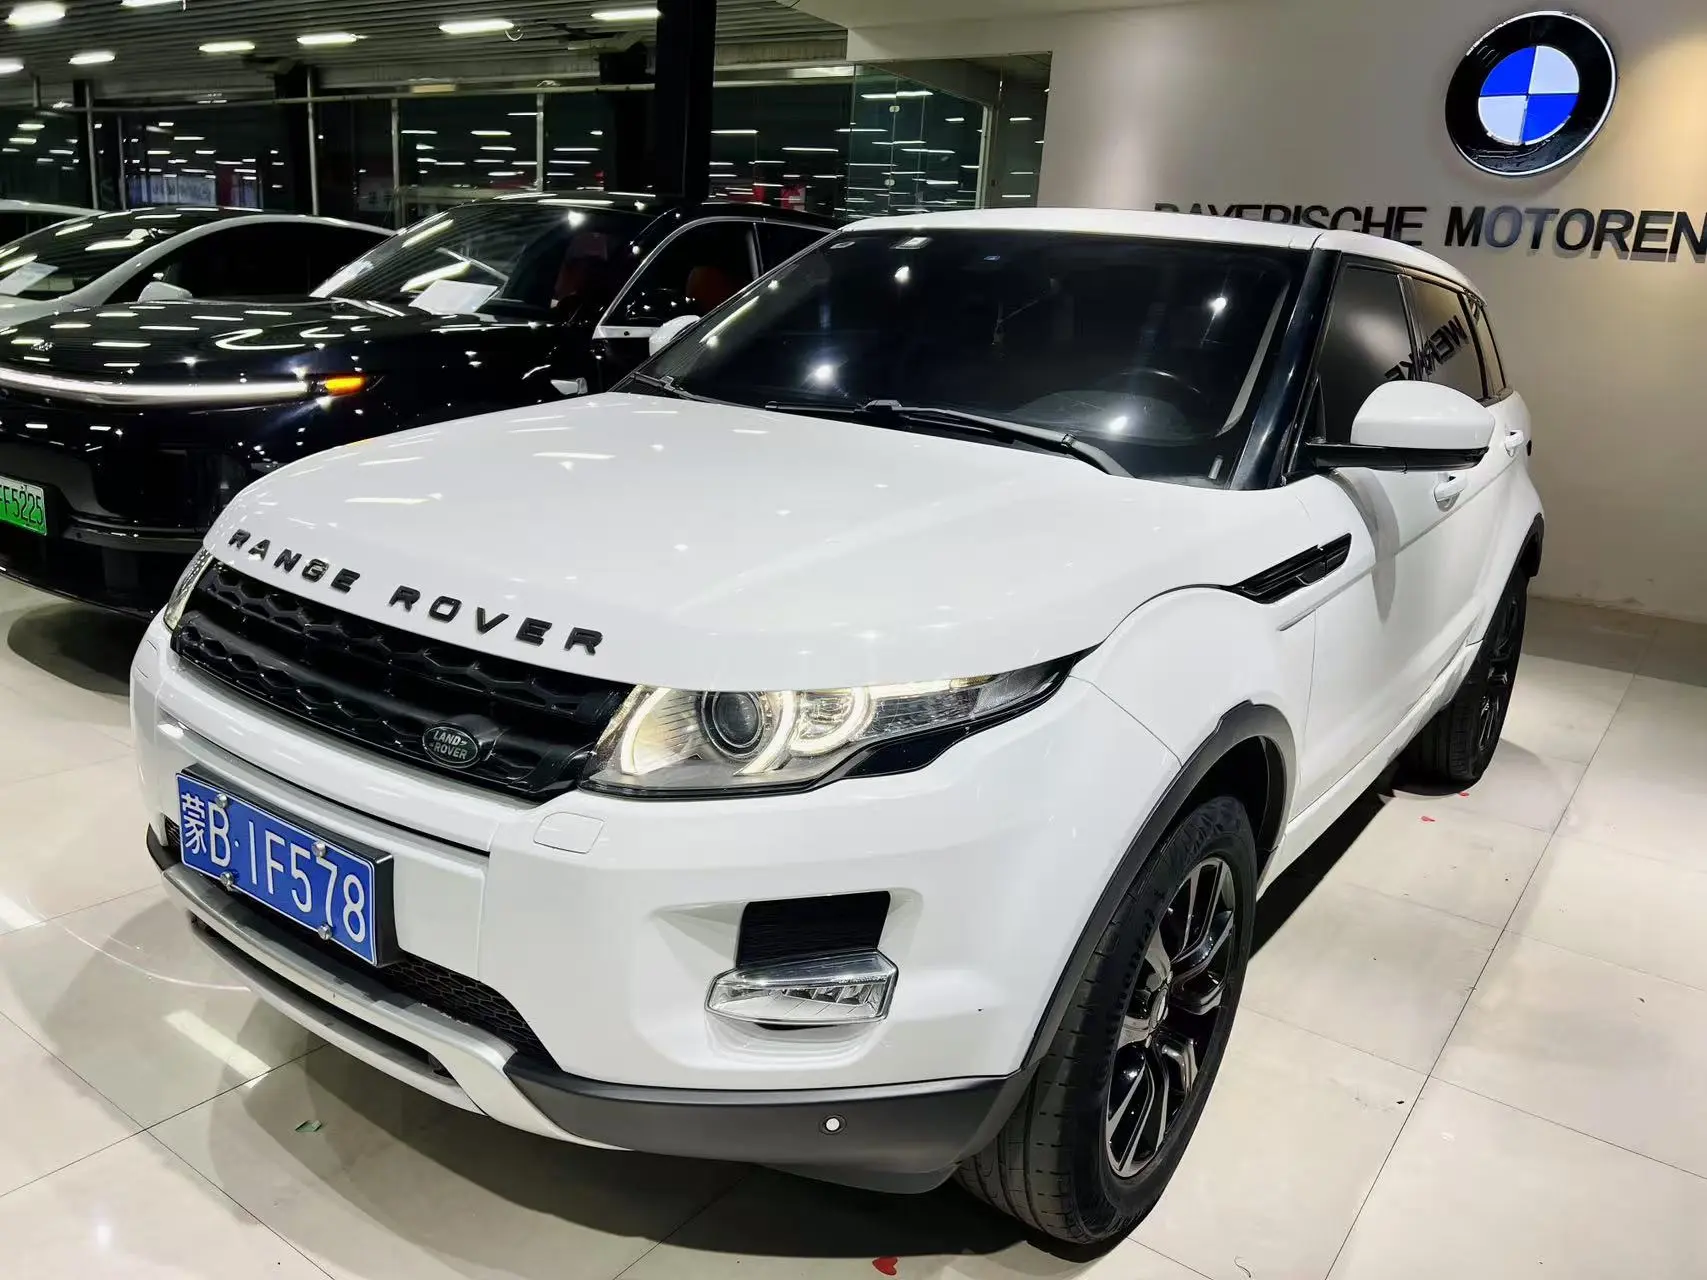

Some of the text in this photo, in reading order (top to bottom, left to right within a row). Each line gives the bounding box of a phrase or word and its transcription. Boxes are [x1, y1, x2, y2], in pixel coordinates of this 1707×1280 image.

[1444, 205, 1707, 257] MOTOREN
[0, 484, 43, 525] F5225
[228, 529, 603, 656] RANGE ROVER
[433, 730, 461, 746] LAND
[434, 742, 468, 759] ROVER
